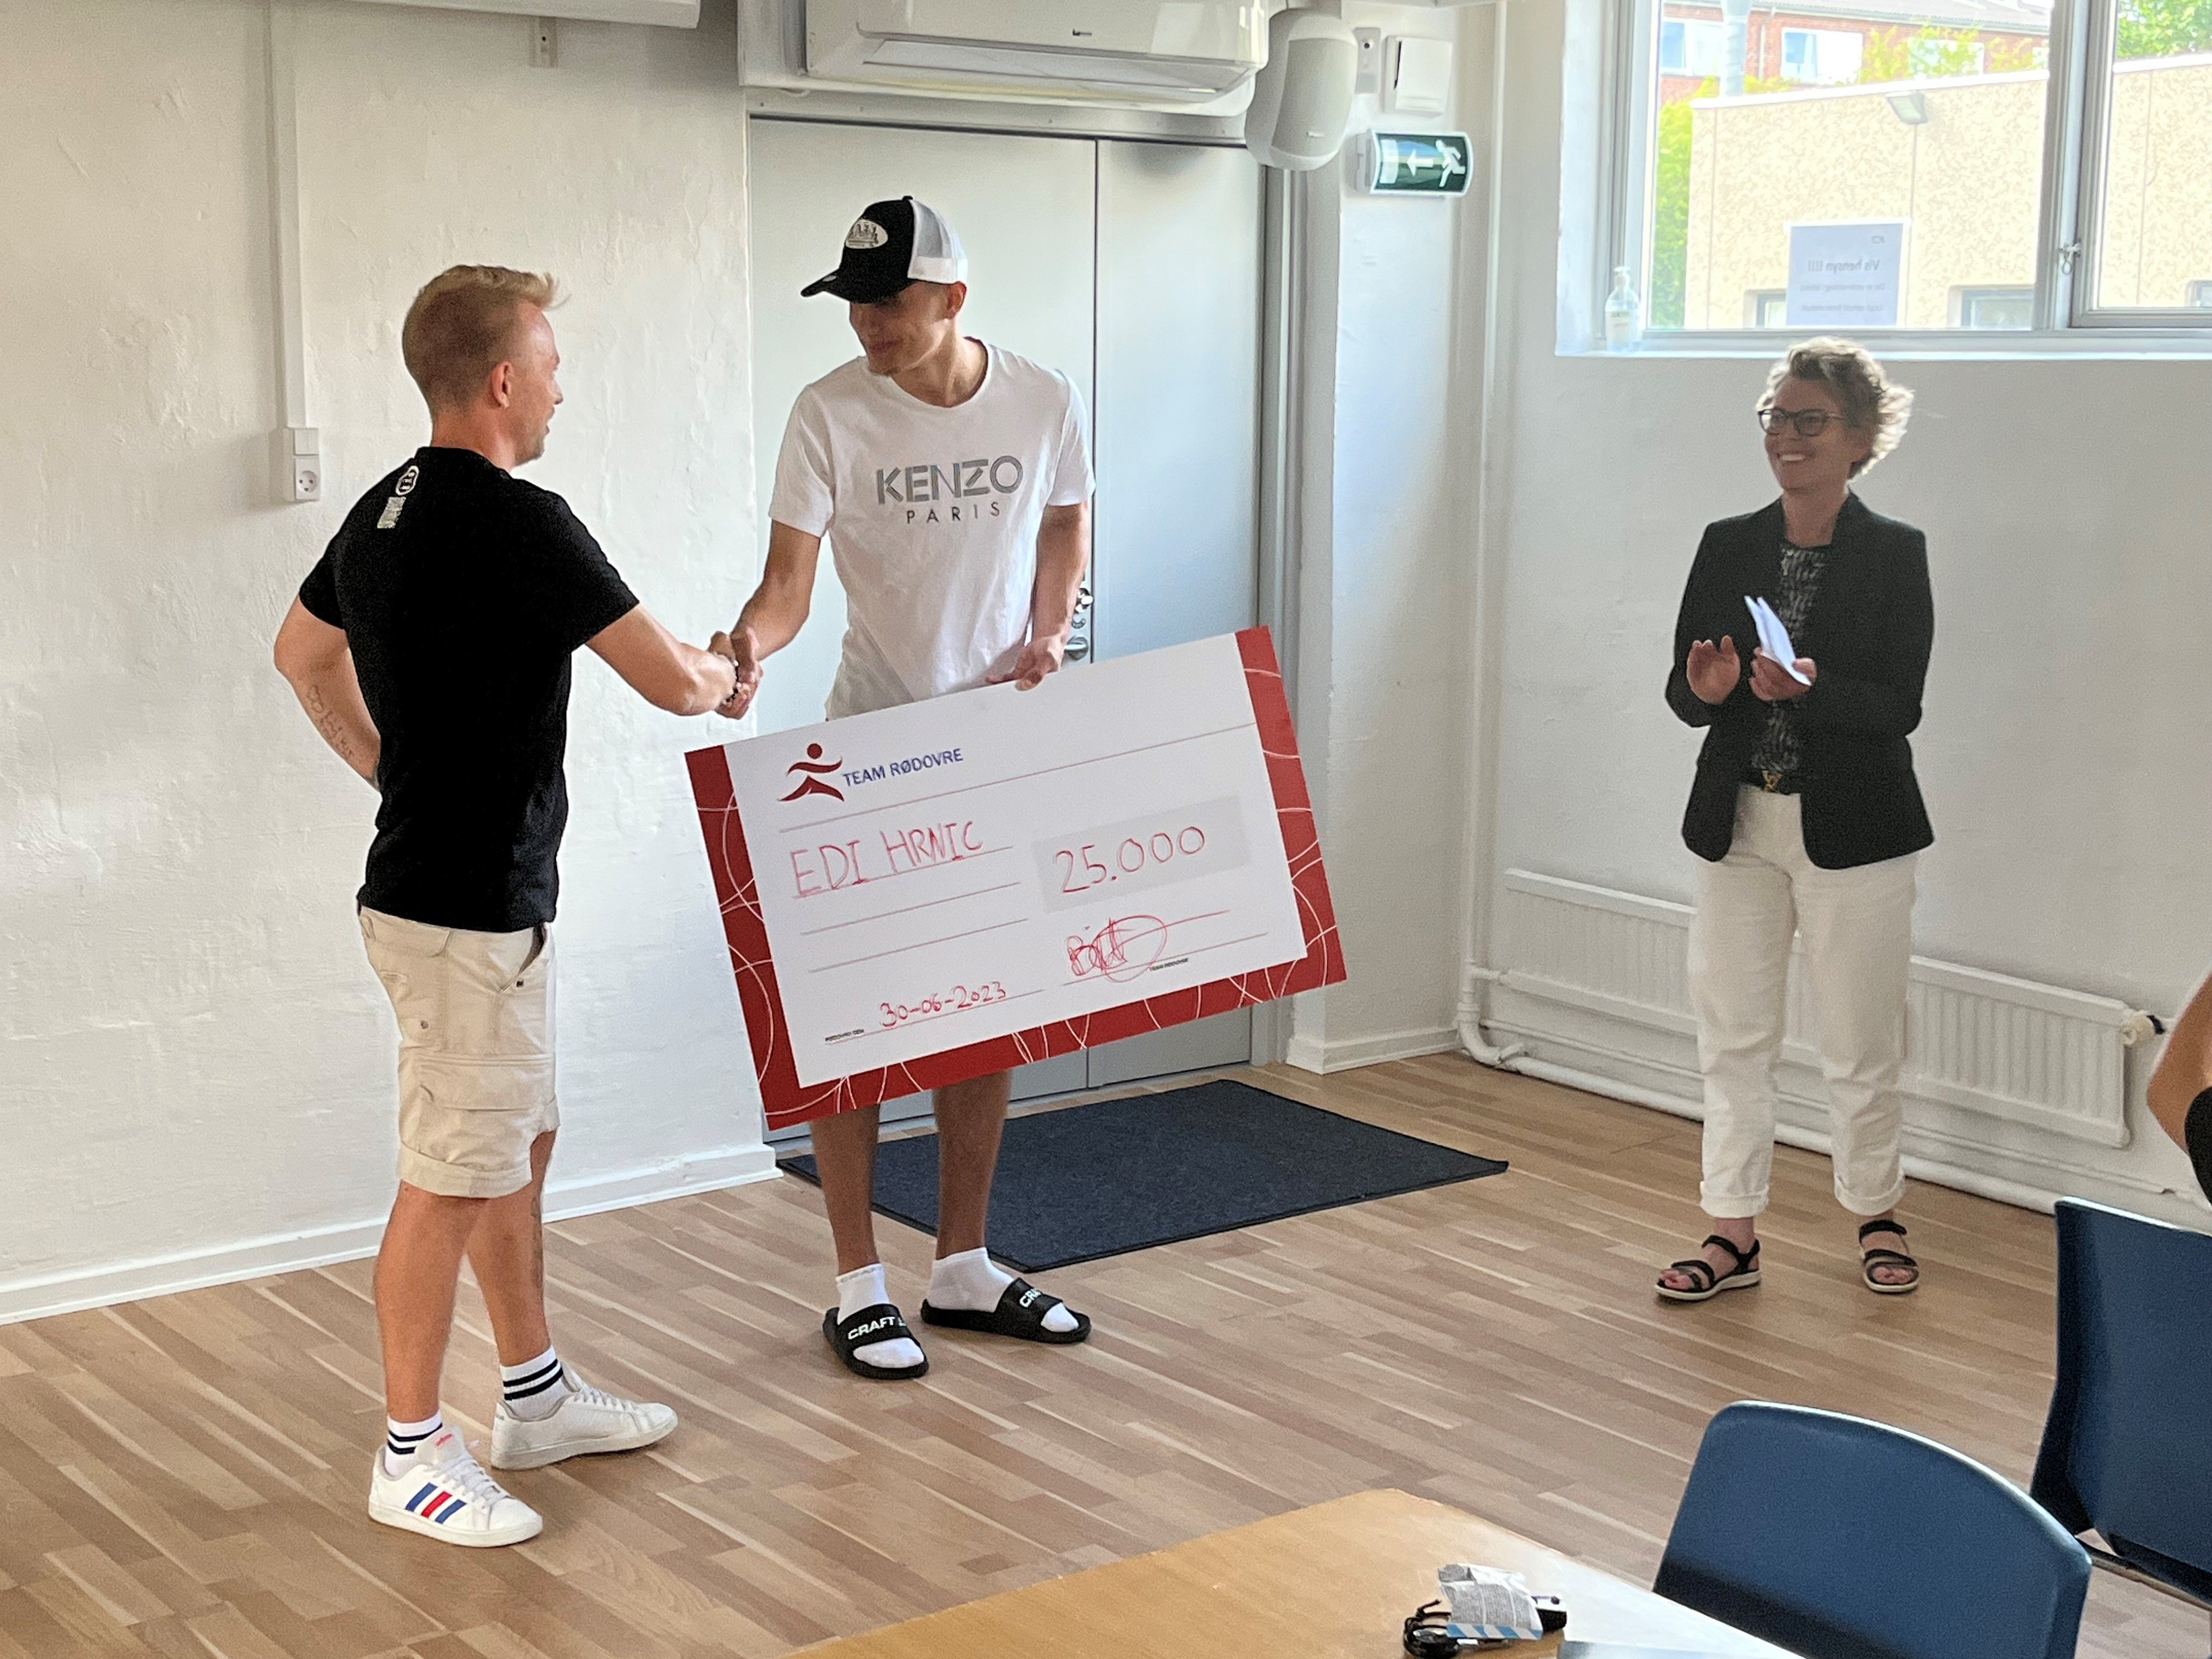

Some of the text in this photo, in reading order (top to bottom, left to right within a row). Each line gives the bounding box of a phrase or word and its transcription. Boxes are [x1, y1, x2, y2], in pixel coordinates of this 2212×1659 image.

[877, 455, 1024, 504] KENZO
[906, 501, 1000, 524] PARIS
[843, 748, 963, 787] TEAM RØDOVRE
[790, 821, 983, 896] EDI HRNIC
[1054, 826, 1205, 893] 25.000
[879, 981, 1006, 1028] 30-06-2023
[1019, 1289, 1041, 1308] CRA
[848, 1316, 895, 1340] CRAFT
